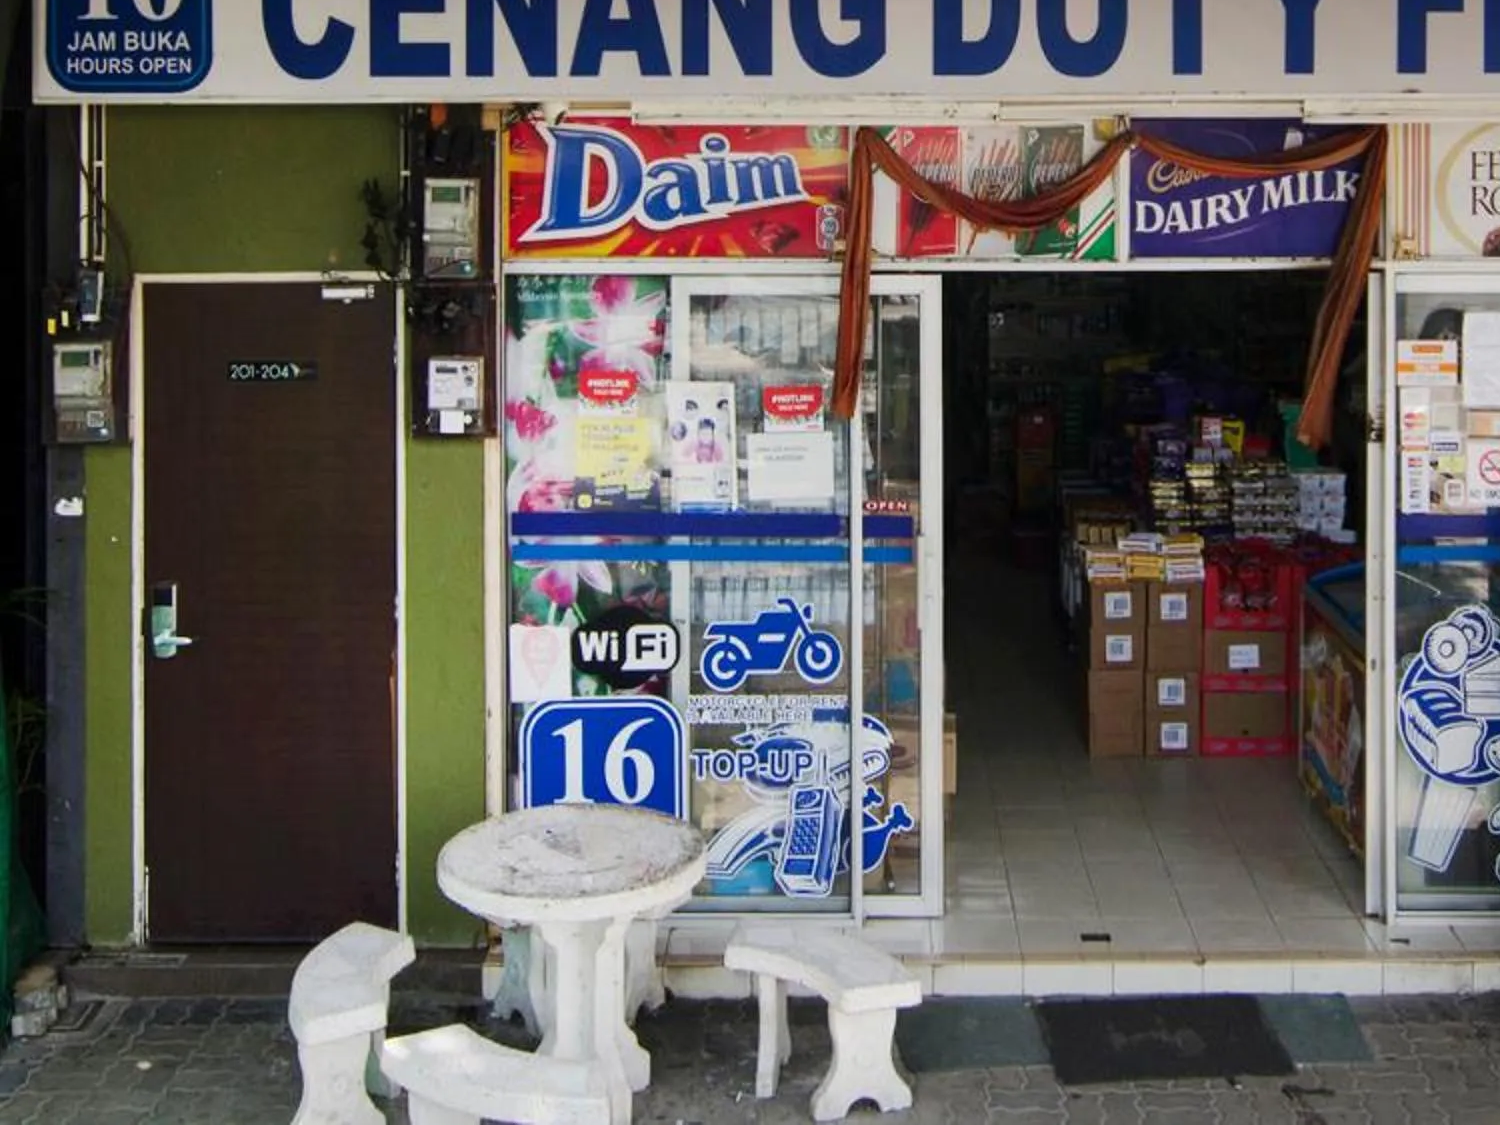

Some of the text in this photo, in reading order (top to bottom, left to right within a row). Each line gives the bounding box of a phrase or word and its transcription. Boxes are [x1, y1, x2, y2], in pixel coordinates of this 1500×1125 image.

[67, 31, 191, 52] JAM BUKA
[67, 58, 193, 74] HOURS OPEN
[532, 124, 806, 236] Daim
[1135, 184, 1257, 235] DAIRY
[1261, 169, 1362, 215] MILK
[230, 363, 289, 379] 201-204
[865, 501, 908, 511] OPEN
[551, 718, 655, 804] 16
[690, 748, 814, 782] TOP-UP
